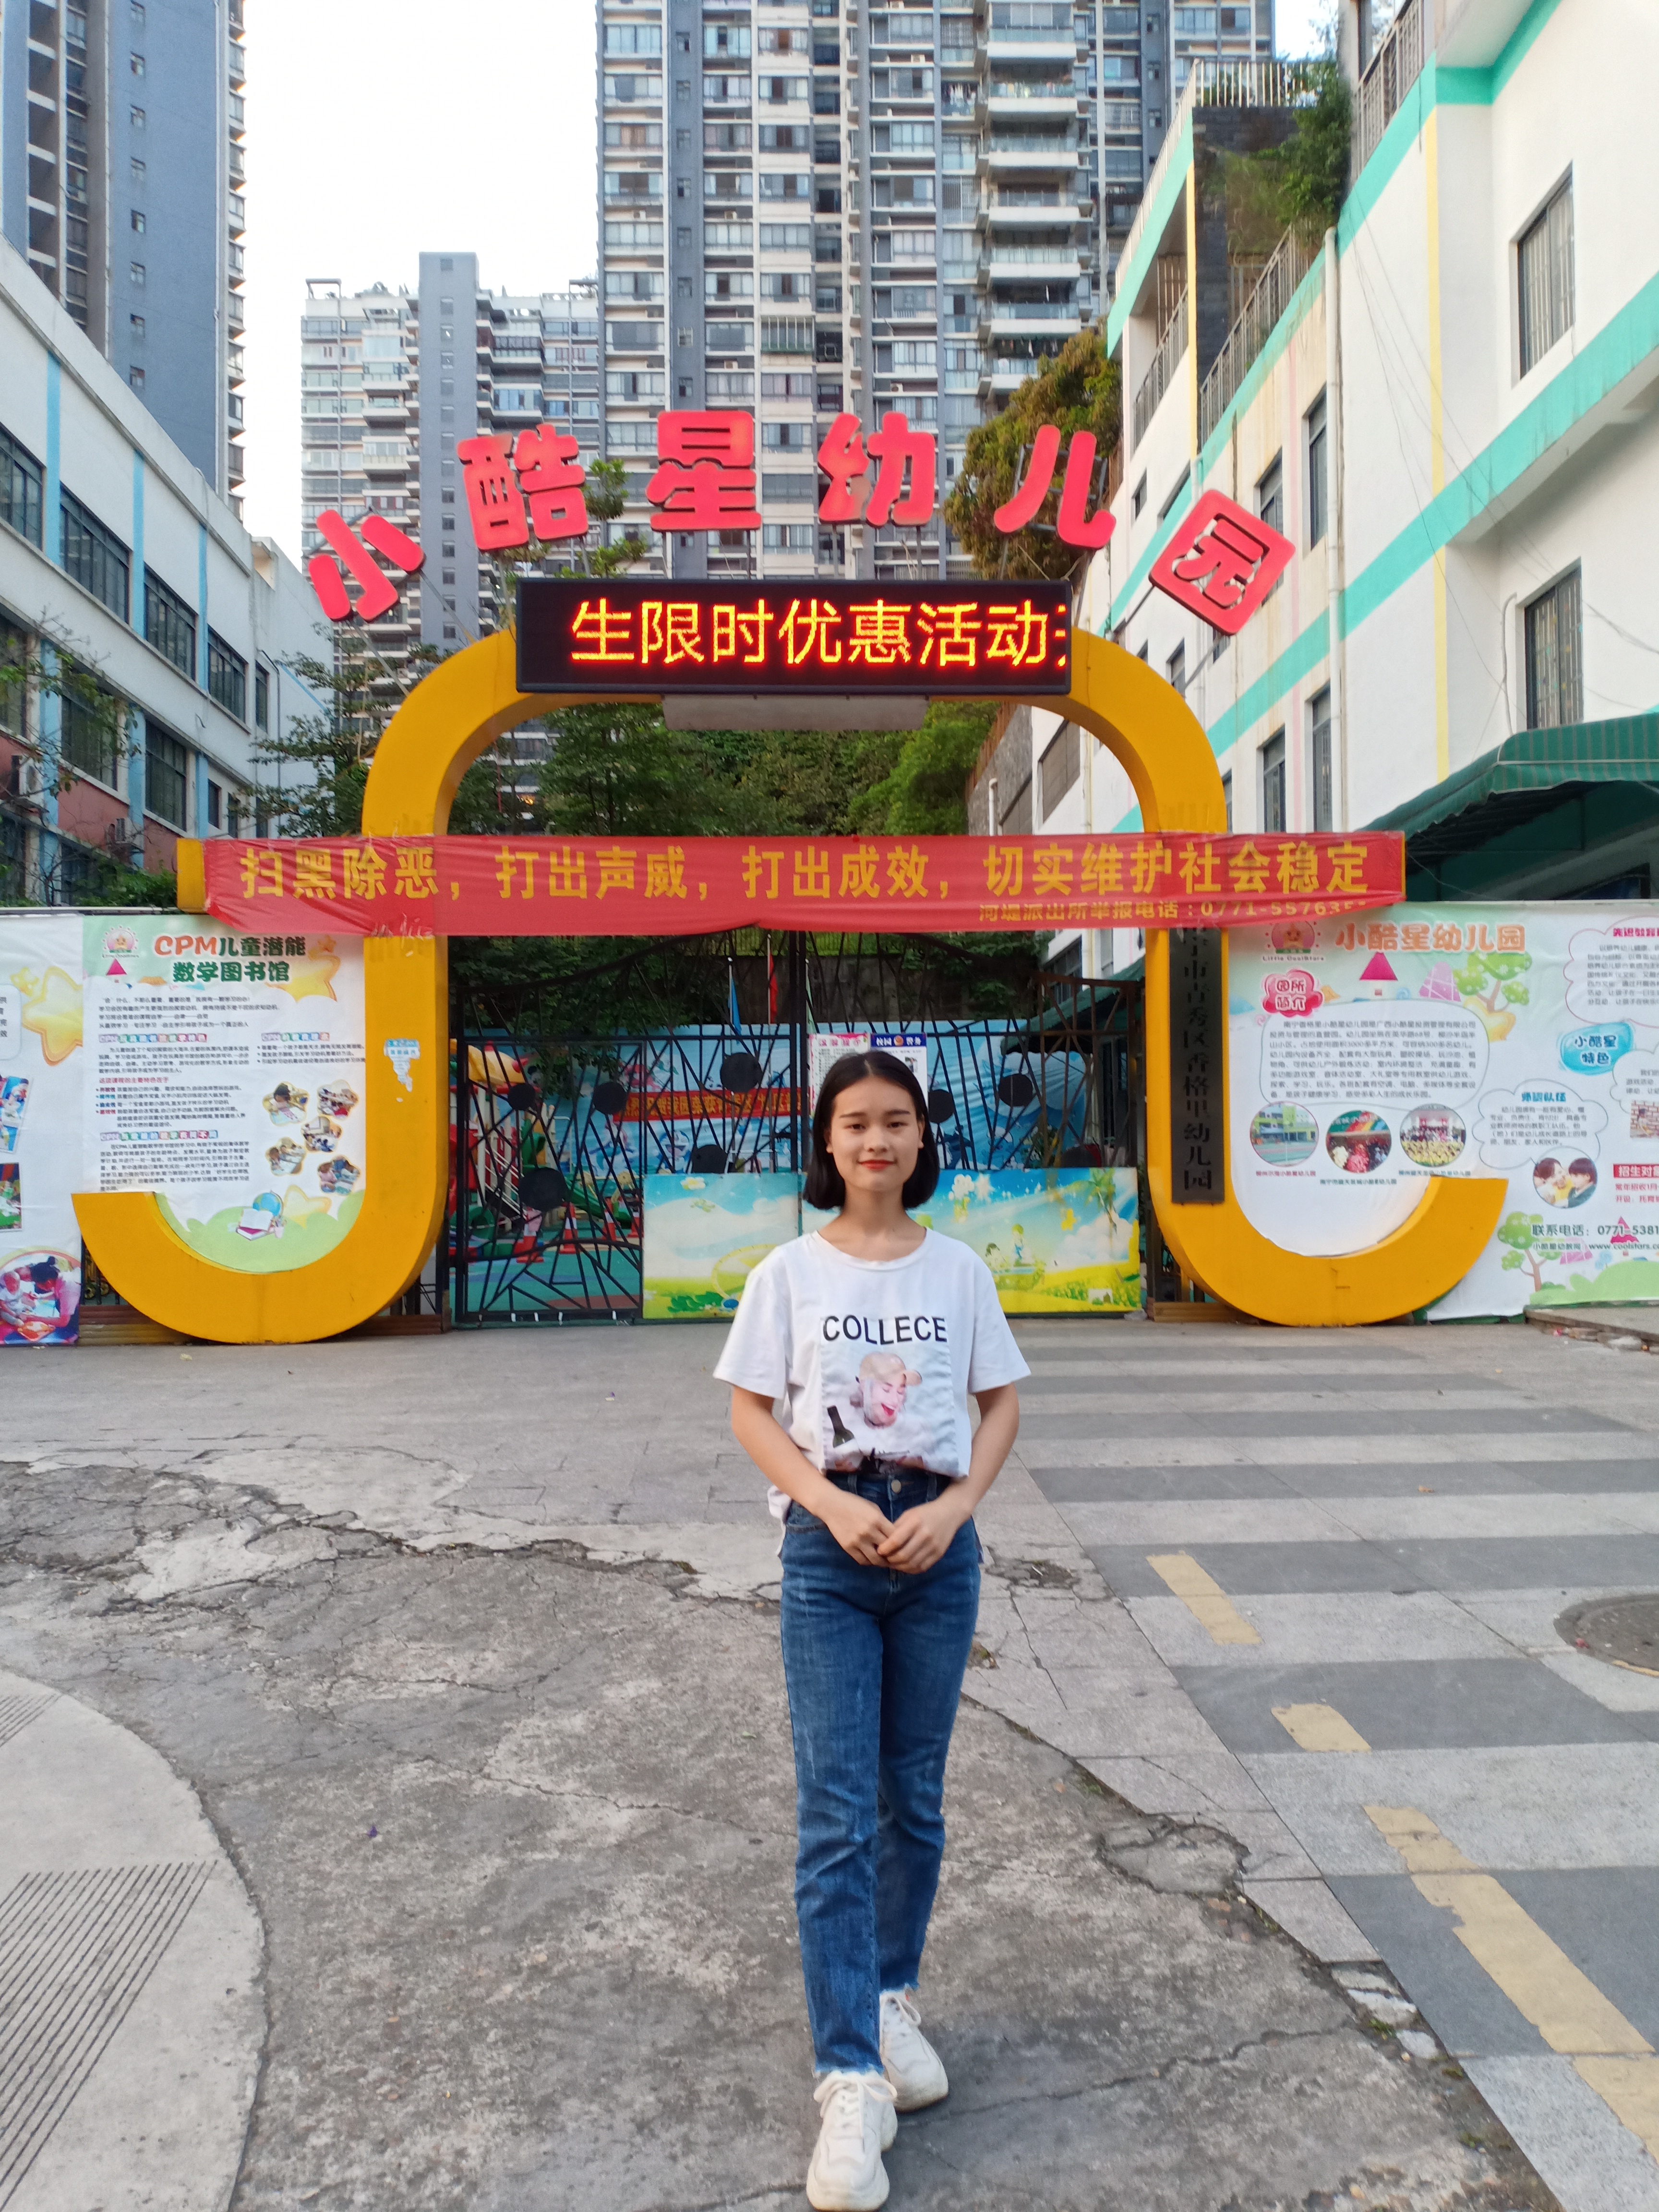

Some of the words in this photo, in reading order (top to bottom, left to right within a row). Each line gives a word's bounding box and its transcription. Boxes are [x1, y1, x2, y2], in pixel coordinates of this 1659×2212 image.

[309, 410, 1296, 636] 小酷星幼儿园
[570, 597, 1066, 667] 生限时优惠活动
[154, 936, 306, 957] CPM儿童潜能
[1335, 923, 1526, 951] 小酷星幼儿园
[173, 961, 290, 983] 数学图书馆
[1277, 996, 1305, 1009] 简介
[1575, 1035, 1616, 1047] 小酷星
[1581, 1052, 1609, 1064] 特色
